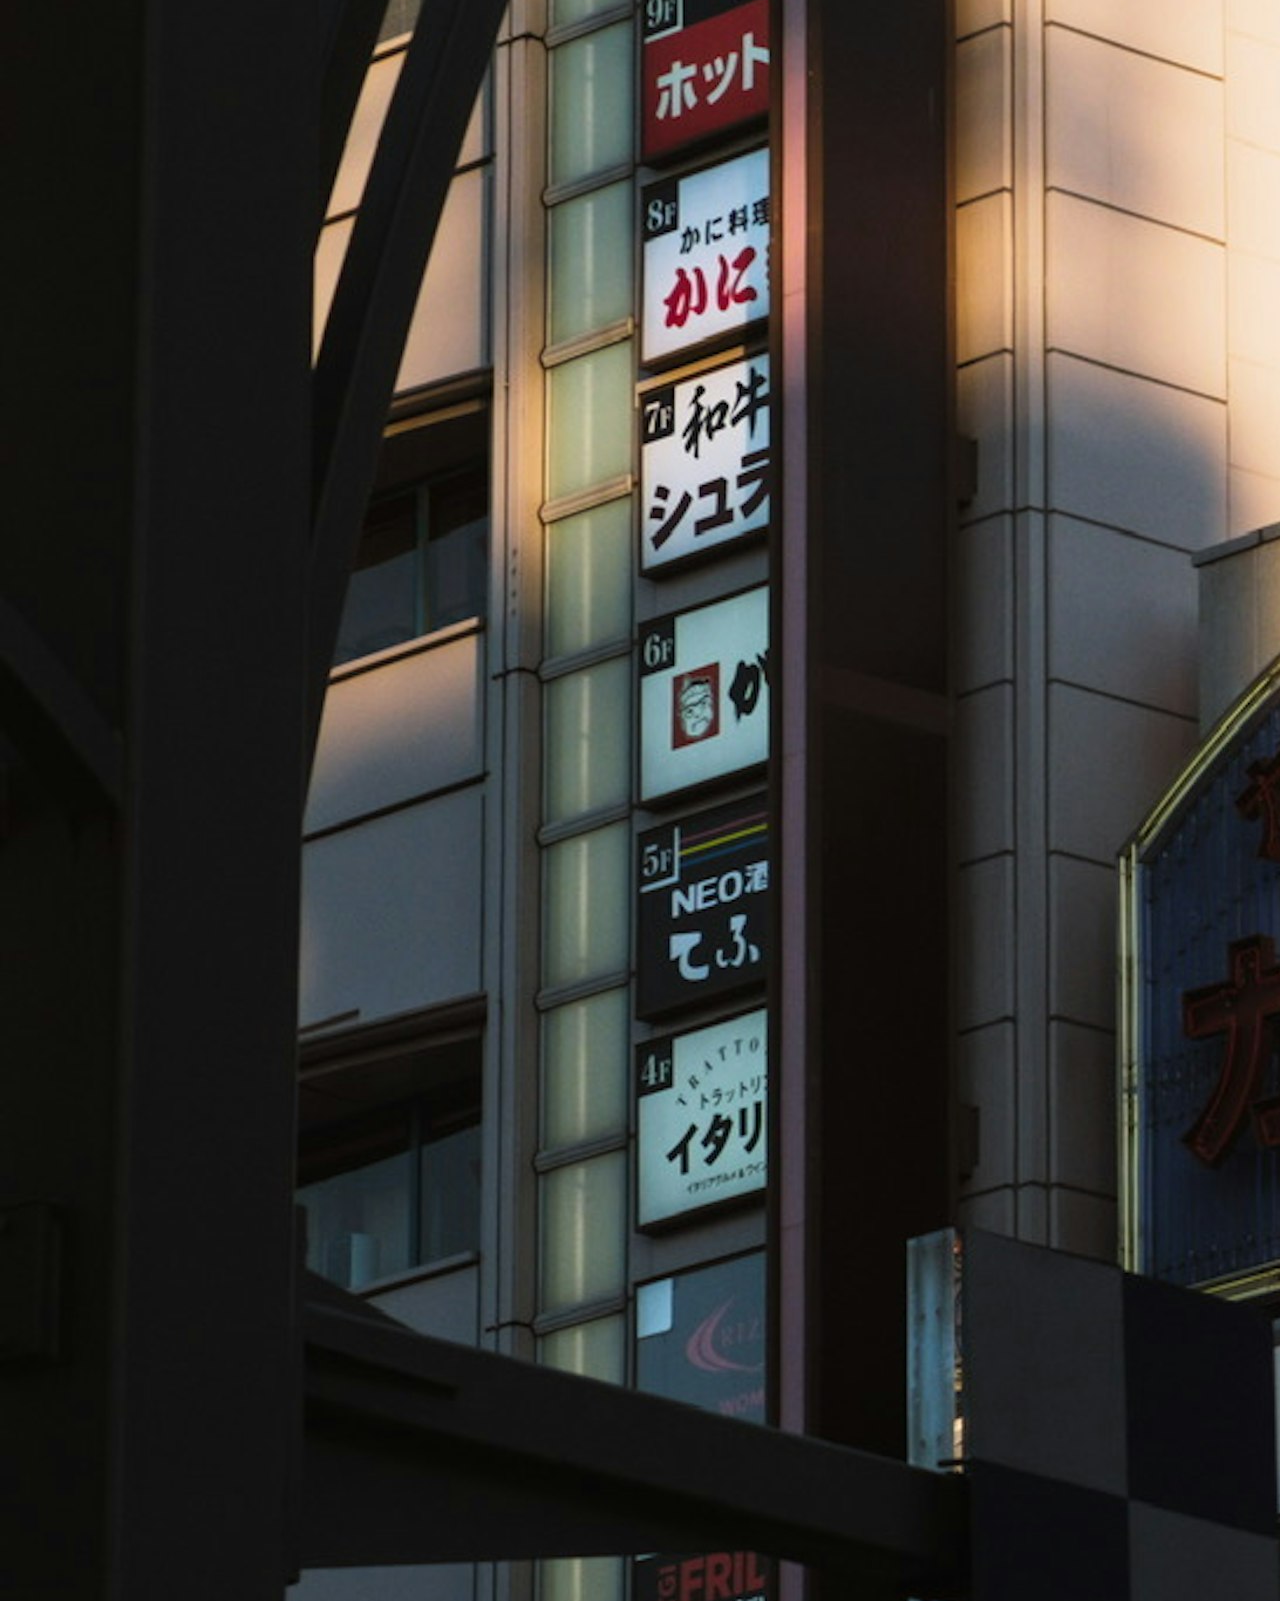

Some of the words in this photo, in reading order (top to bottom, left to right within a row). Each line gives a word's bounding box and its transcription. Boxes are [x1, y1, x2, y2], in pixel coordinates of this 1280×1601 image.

[655, 31, 771, 121] ホット
[645, 198, 676, 233] 8F
[664, 246, 770, 328] かに
[643, 400, 673, 437] 7F
[641, 631, 673, 667] 6F
[642, 842, 672, 878] 5F
[641, 1053, 671, 1087] 4F
[675, 1036, 767, 1107] TRATTO
[665, 1100, 763, 1176] イタリ
